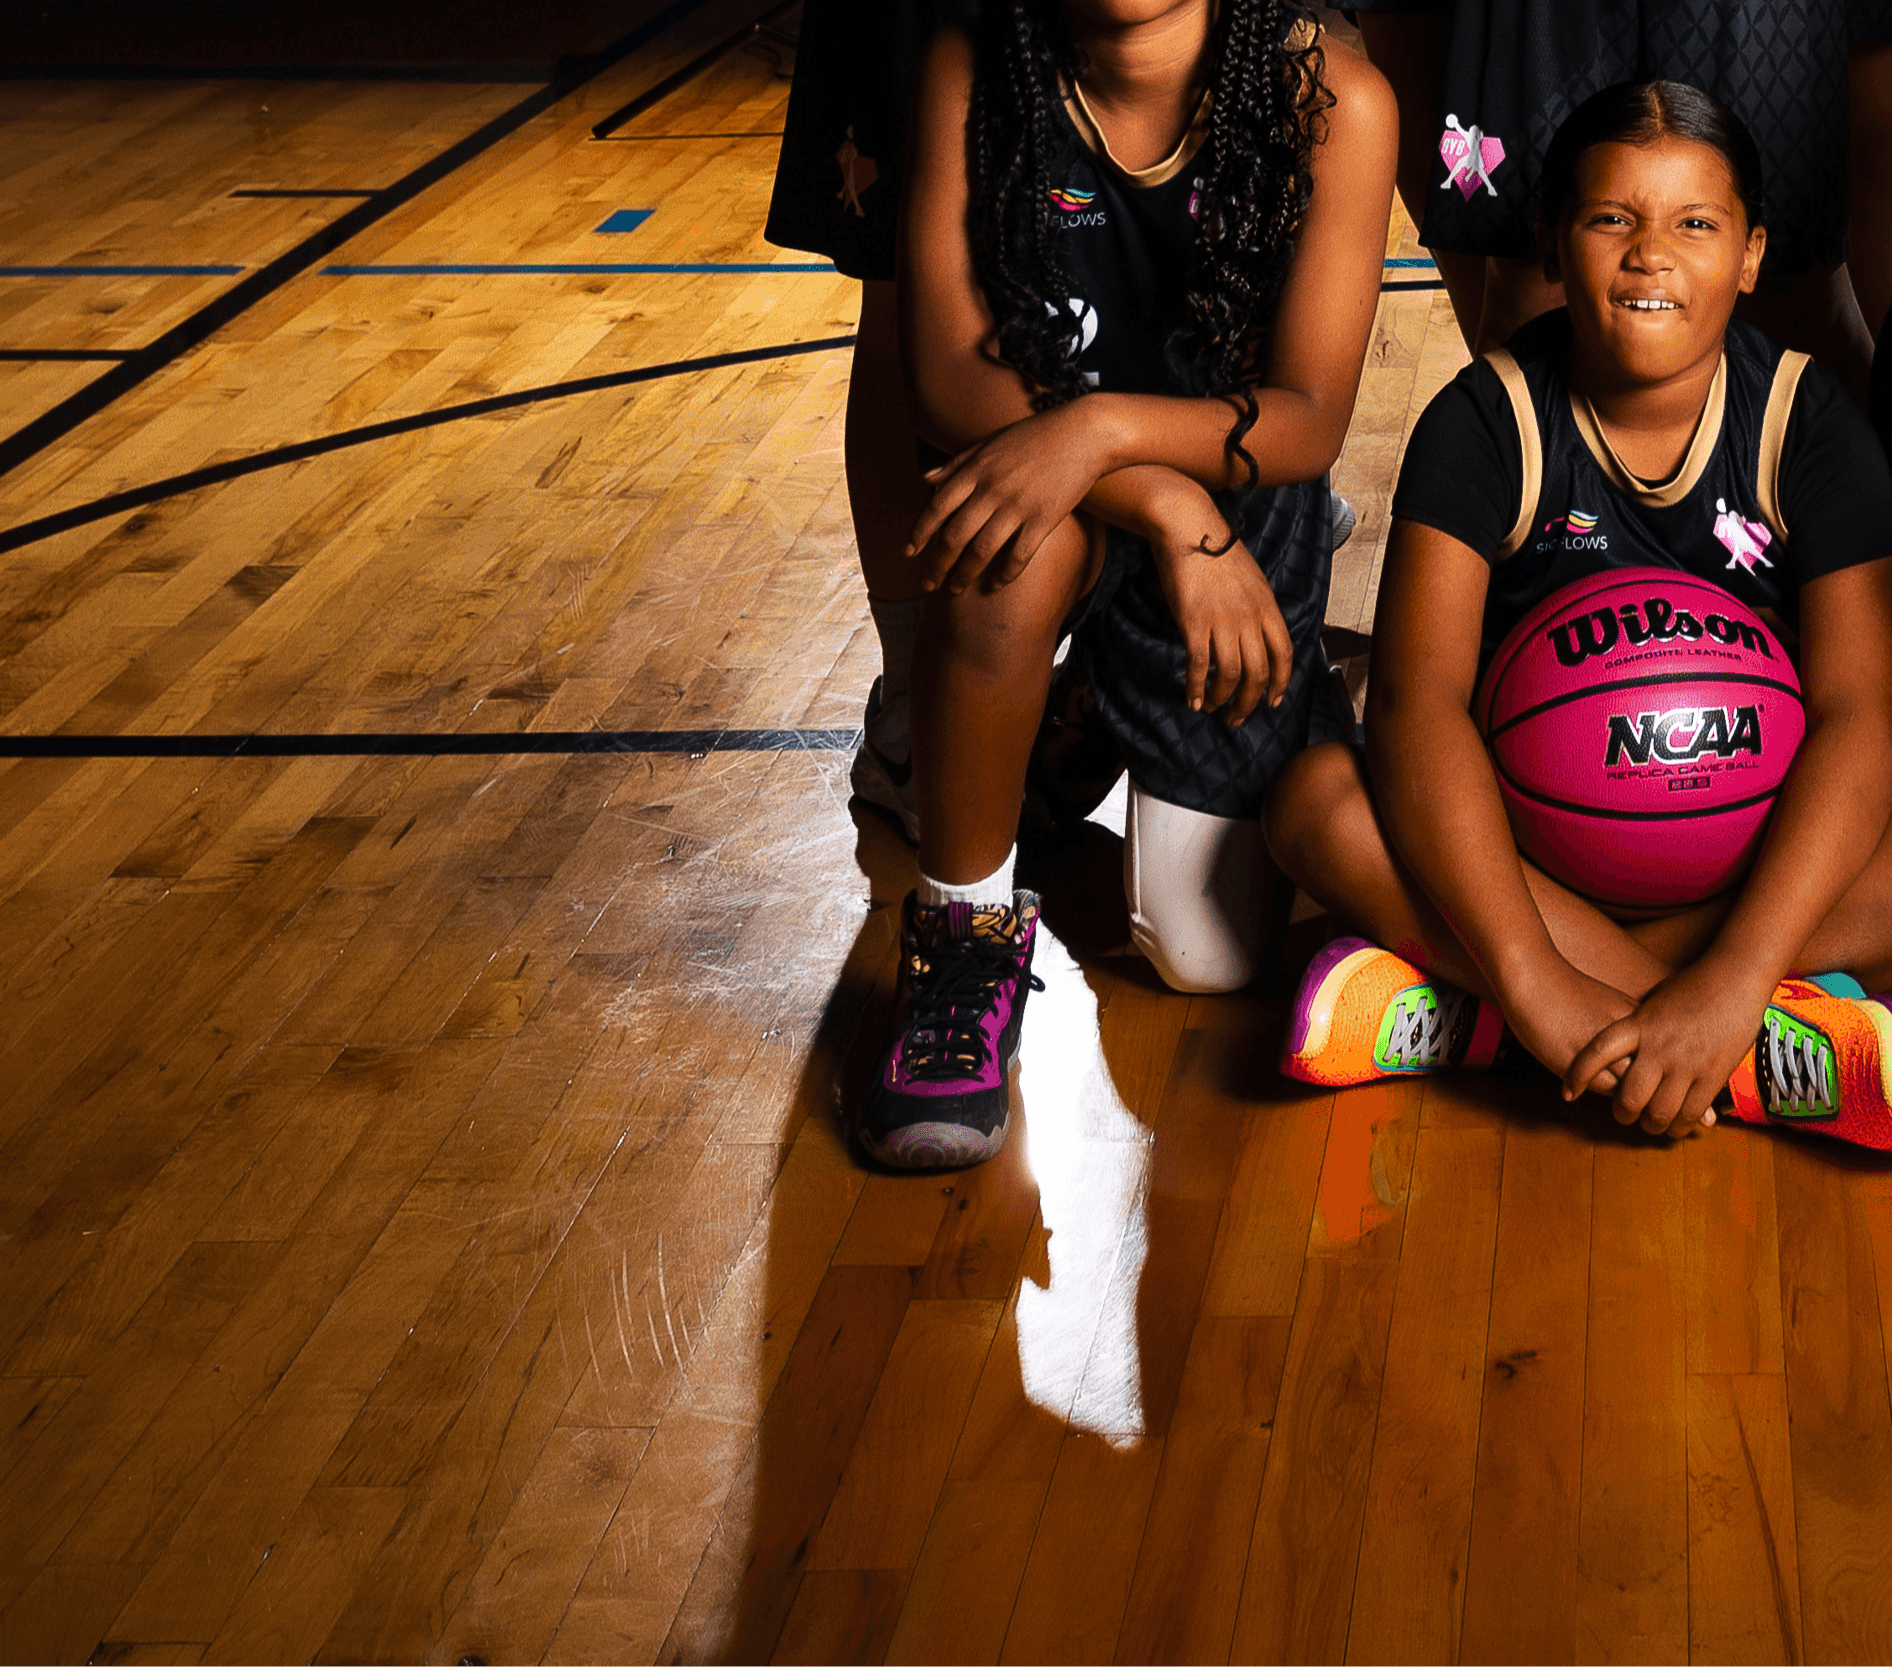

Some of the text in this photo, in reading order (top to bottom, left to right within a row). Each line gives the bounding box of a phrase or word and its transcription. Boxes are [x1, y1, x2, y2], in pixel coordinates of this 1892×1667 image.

[1547, 597, 1774, 668] Wilson
[1604, 648, 1743, 670] COMPOSITE LEATHER
[1603, 705, 1763, 768] NCAA
[1607, 760, 1760, 781] REPLICA GAME BALL
